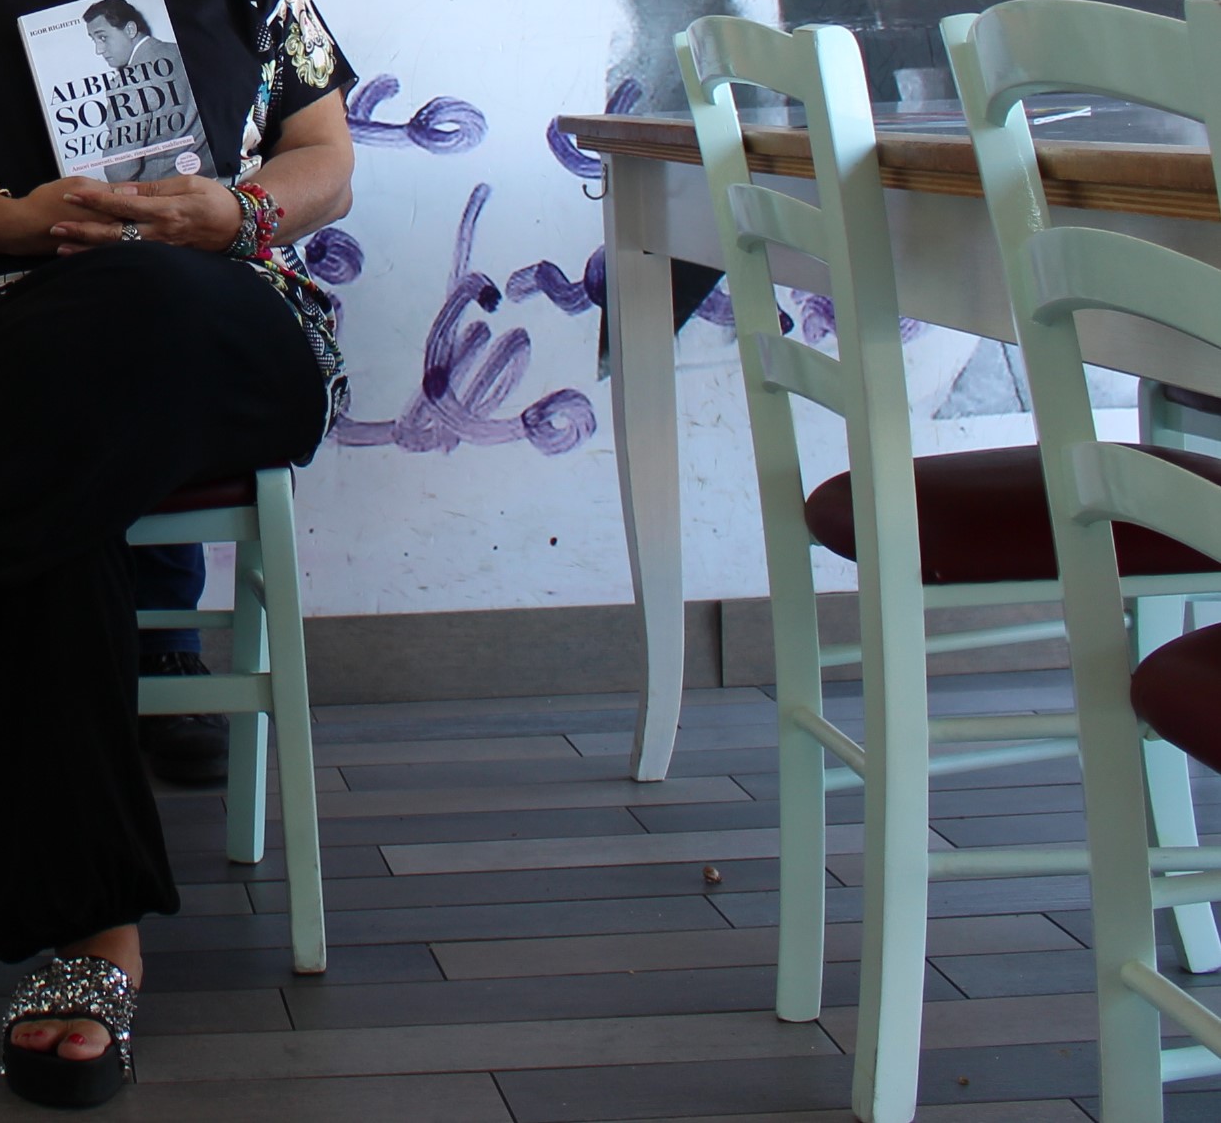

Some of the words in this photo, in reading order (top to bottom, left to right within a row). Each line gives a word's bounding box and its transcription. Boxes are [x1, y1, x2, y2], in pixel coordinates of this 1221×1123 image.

[29, 25, 48, 37] IGOR
[48, 18, 81, 32] RIGHETTI
[50, 57, 175, 106] ALBERTO
[55, 79, 183, 136] SORDI
[64, 111, 186, 160] SEGRETO
